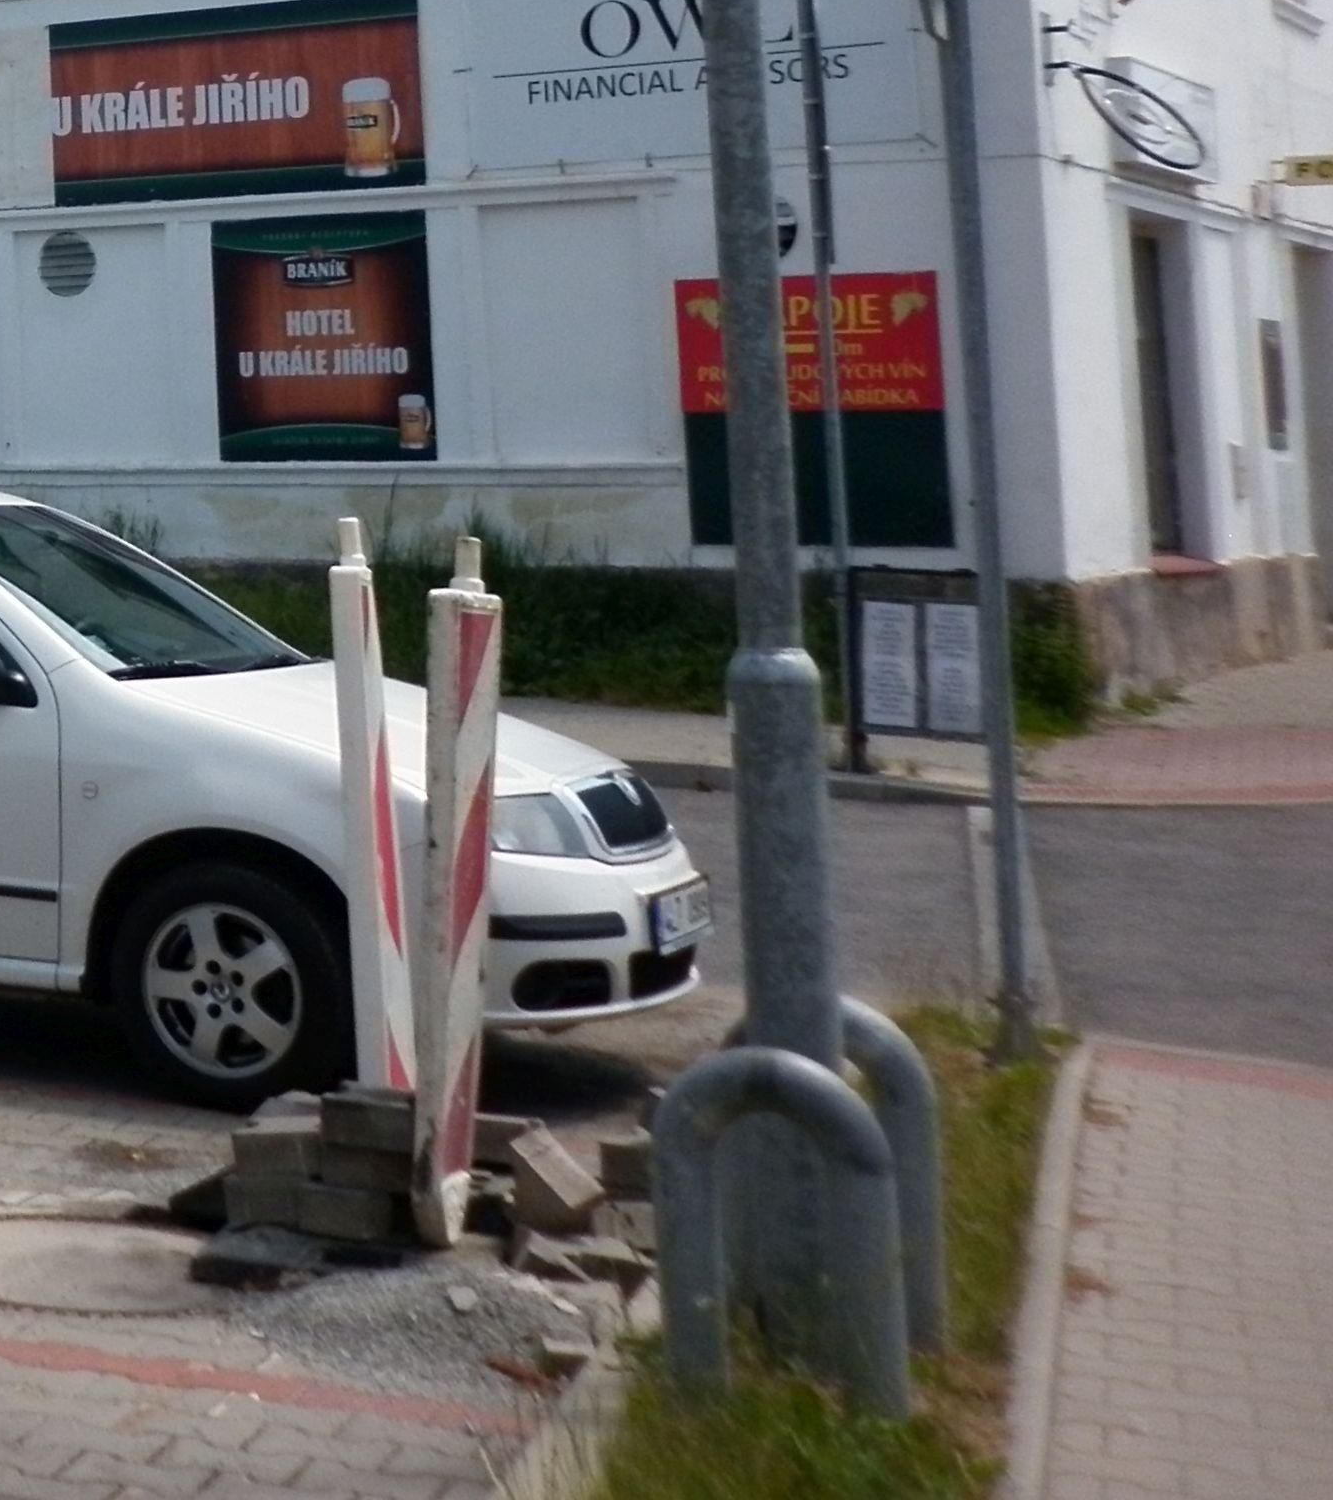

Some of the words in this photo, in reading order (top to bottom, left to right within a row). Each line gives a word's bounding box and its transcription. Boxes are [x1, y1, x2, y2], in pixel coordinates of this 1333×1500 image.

[527, 69, 684, 105] FINANCIAL
[694, 53, 849, 90] ASORS
[52, 95, 72, 136] U
[81, 81, 183, 133] KRÁLE
[192, 72, 309, 126] JIŘÍHO
[286, 308, 355, 337] HOTEL
[782, 293, 881, 329] POJE
[238, 350, 254, 377] U
[259, 344, 327, 376] KRÁLE
[333, 342, 409, 376] JIŘÍHO
[840, 384, 920, 404] ABÍDKA
